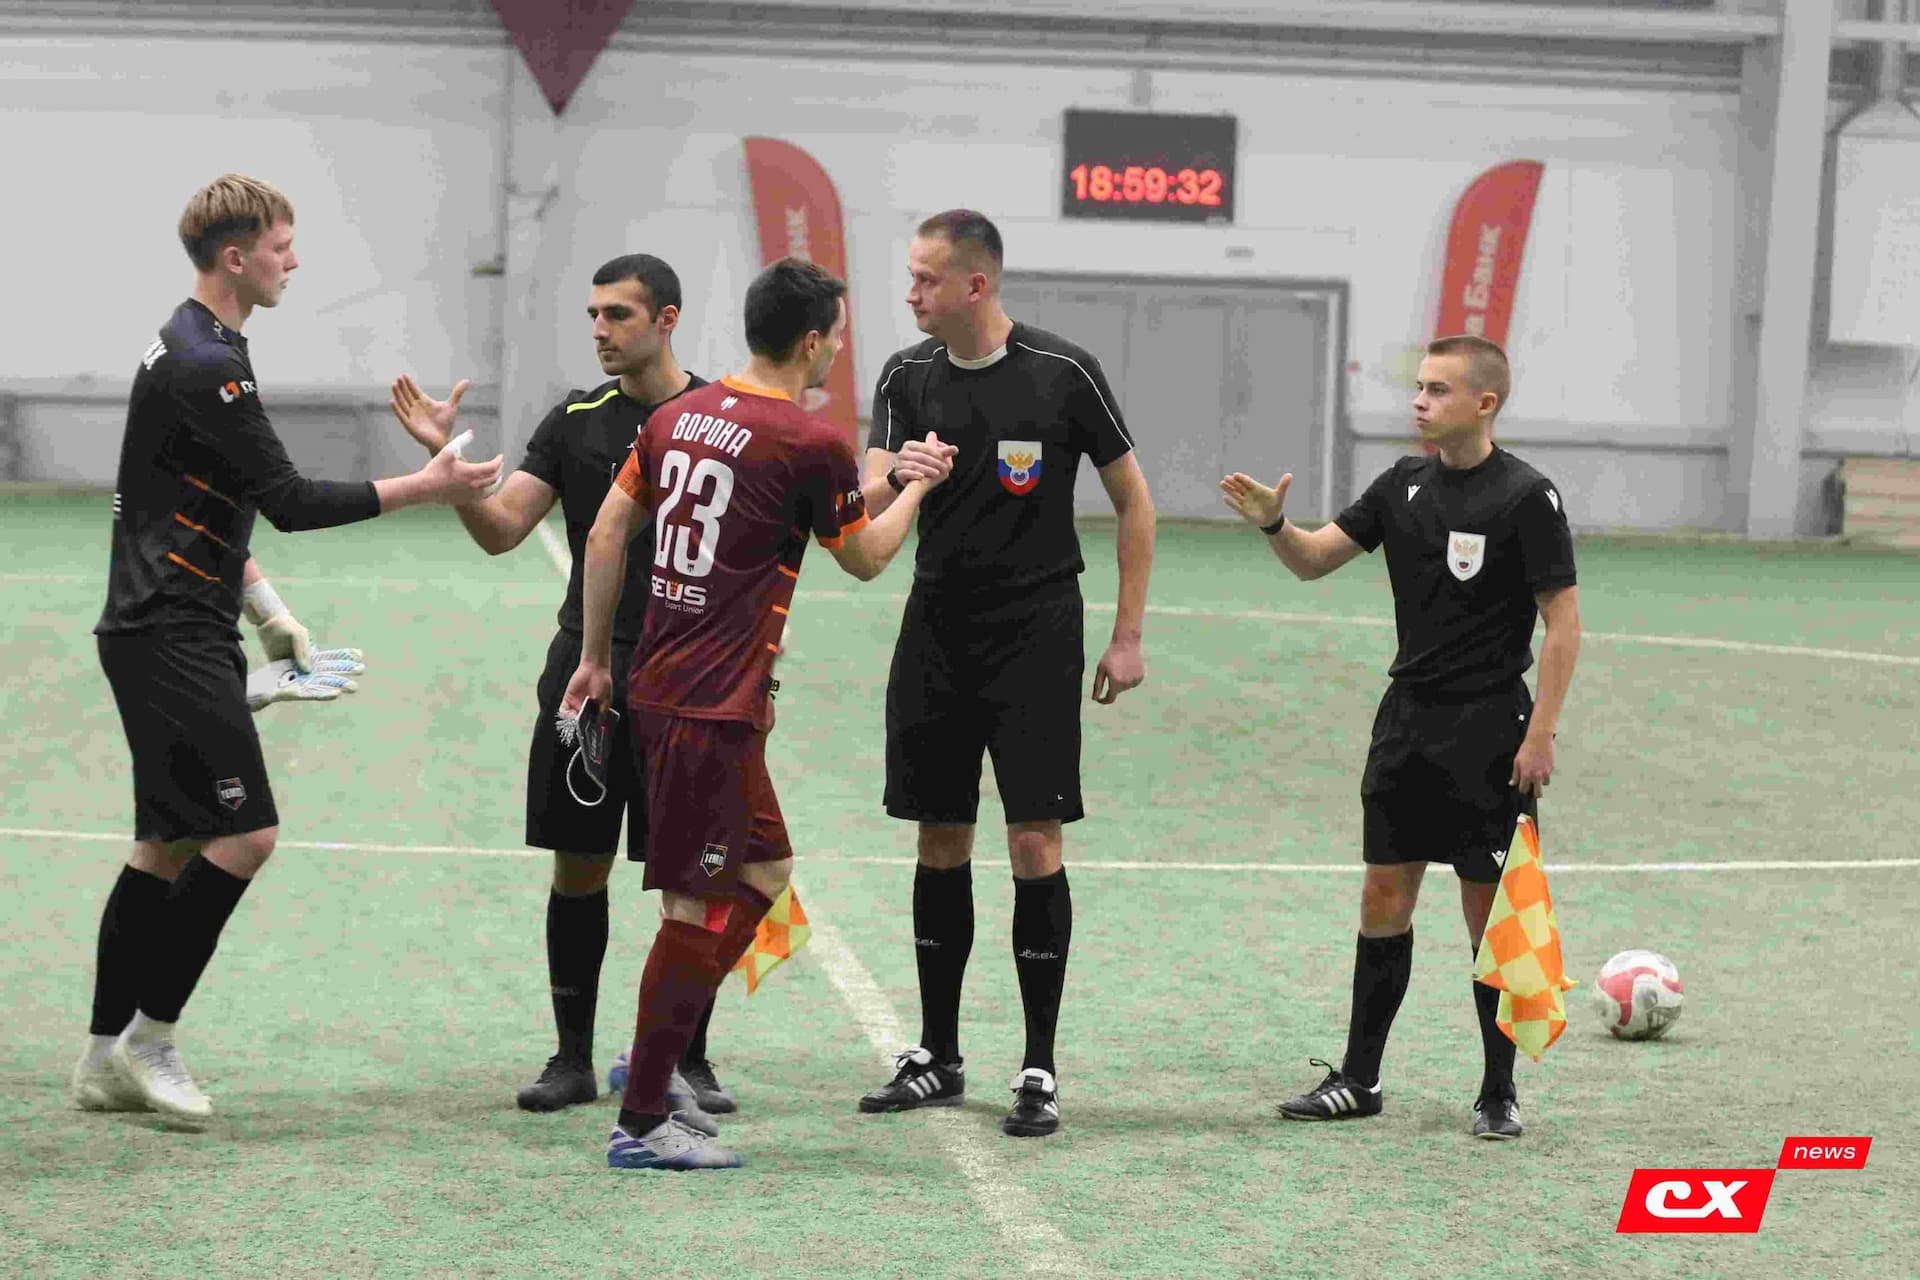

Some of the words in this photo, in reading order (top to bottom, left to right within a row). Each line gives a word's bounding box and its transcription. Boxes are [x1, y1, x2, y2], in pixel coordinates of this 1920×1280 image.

[1070, 164, 1223, 206] 18:59:32
[671, 412, 752, 458] ВОРОНА
[653, 449, 735, 578] 23
